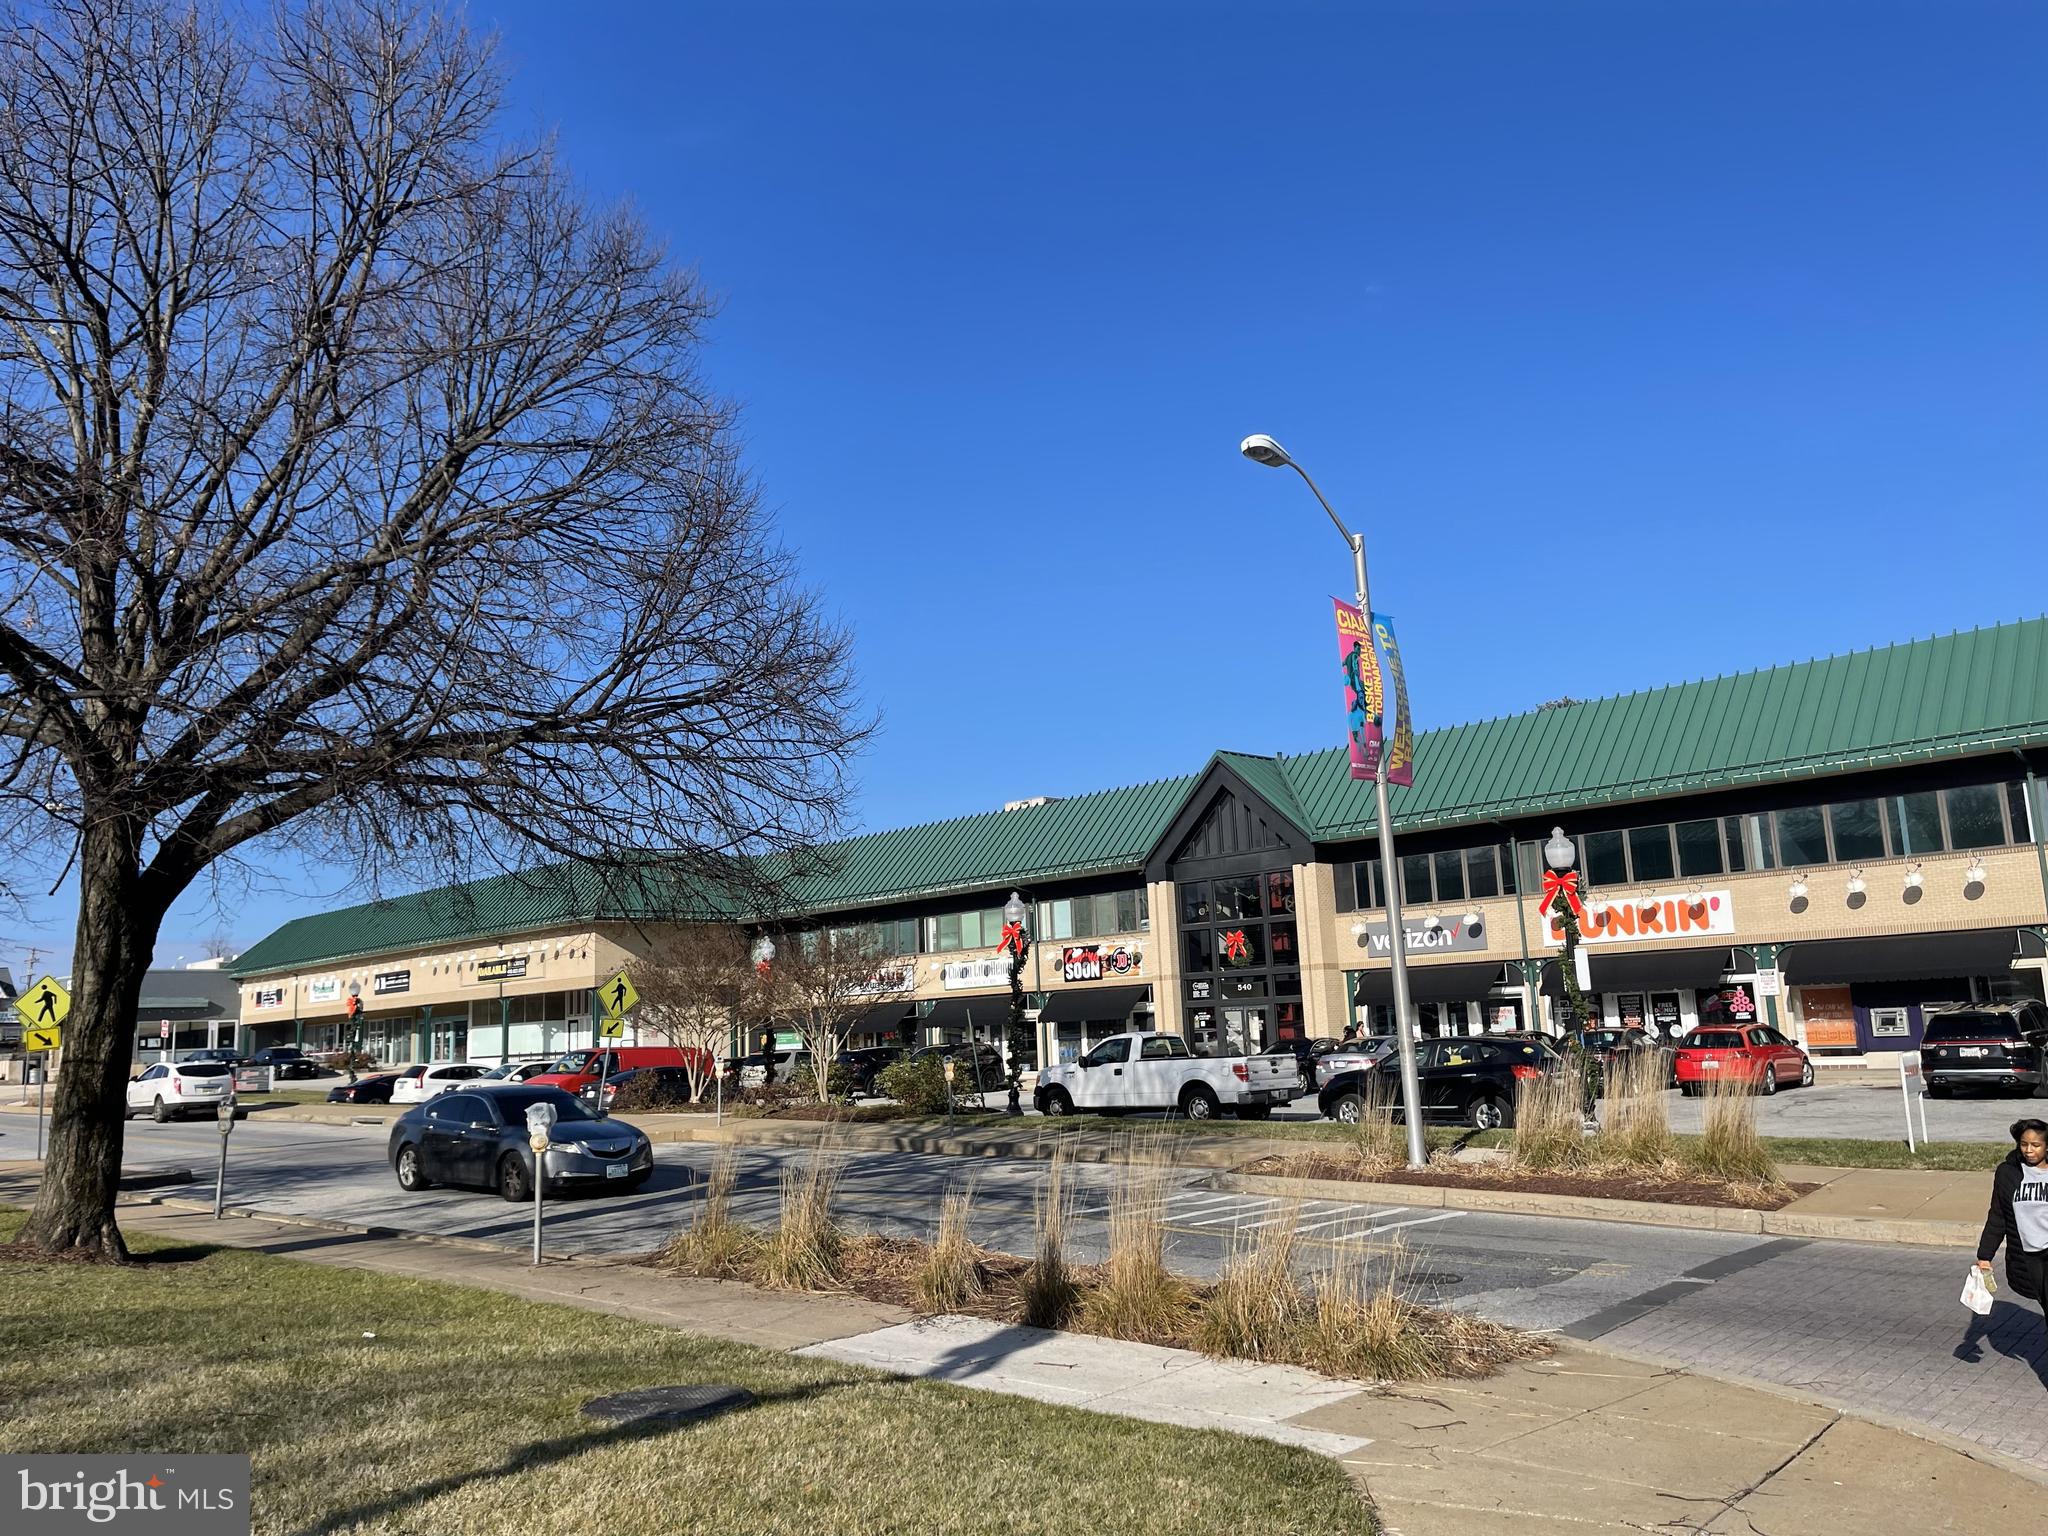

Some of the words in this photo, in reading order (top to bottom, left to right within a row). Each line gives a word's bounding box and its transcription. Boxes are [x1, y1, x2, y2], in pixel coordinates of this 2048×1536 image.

[1337, 608, 1368, 634] CIAA
[1359, 638, 1375, 723] BASKETBALL
[1366, 640, 1383, 715] TOURNAMENT
[1387, 655, 1405, 769] WELCOME
[1372, 928, 1453, 951] veizon
[1065, 960, 1101, 980] SOON
[1237, 983, 1252, 991] 540
